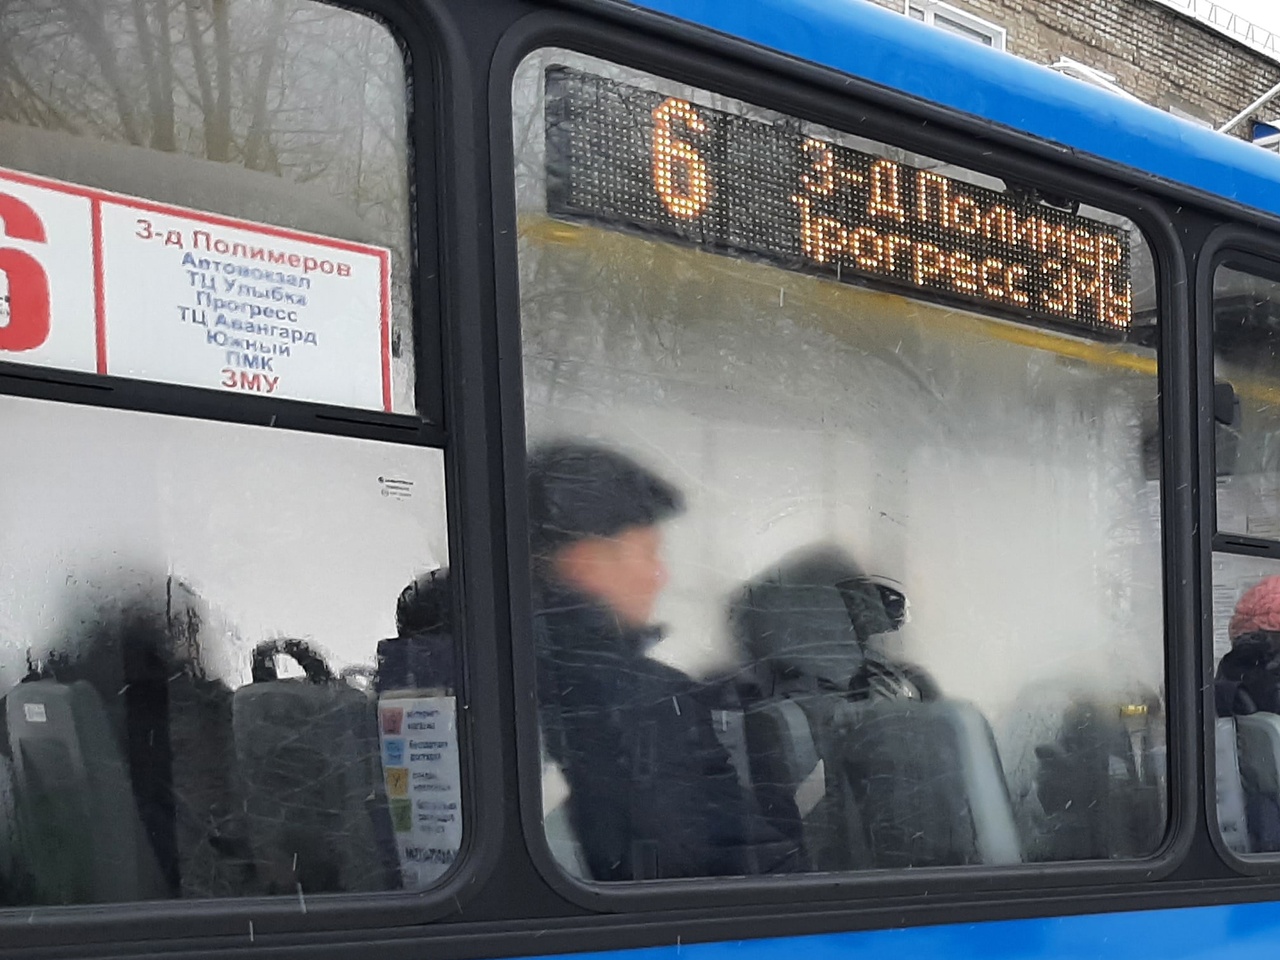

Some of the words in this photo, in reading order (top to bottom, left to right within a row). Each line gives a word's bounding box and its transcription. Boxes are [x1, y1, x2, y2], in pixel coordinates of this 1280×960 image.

[652, 96, 709, 218] 6
[917, 170, 1121, 268] Полимер
[181, 251, 311, 290] Автовокзал
[192, 229, 353, 277] Полимеров
[187, 270, 217, 292] ТЦ
[225, 279, 308, 307] Улыбка
[196, 290, 298, 323] Прогресс
[178, 305, 208, 328] ТЦ
[215, 314, 318, 346] Авангард
[206, 329, 291, 357] Южный
[225, 350, 274, 372] ПМК
[221, 368, 280, 394] ЗМУ
